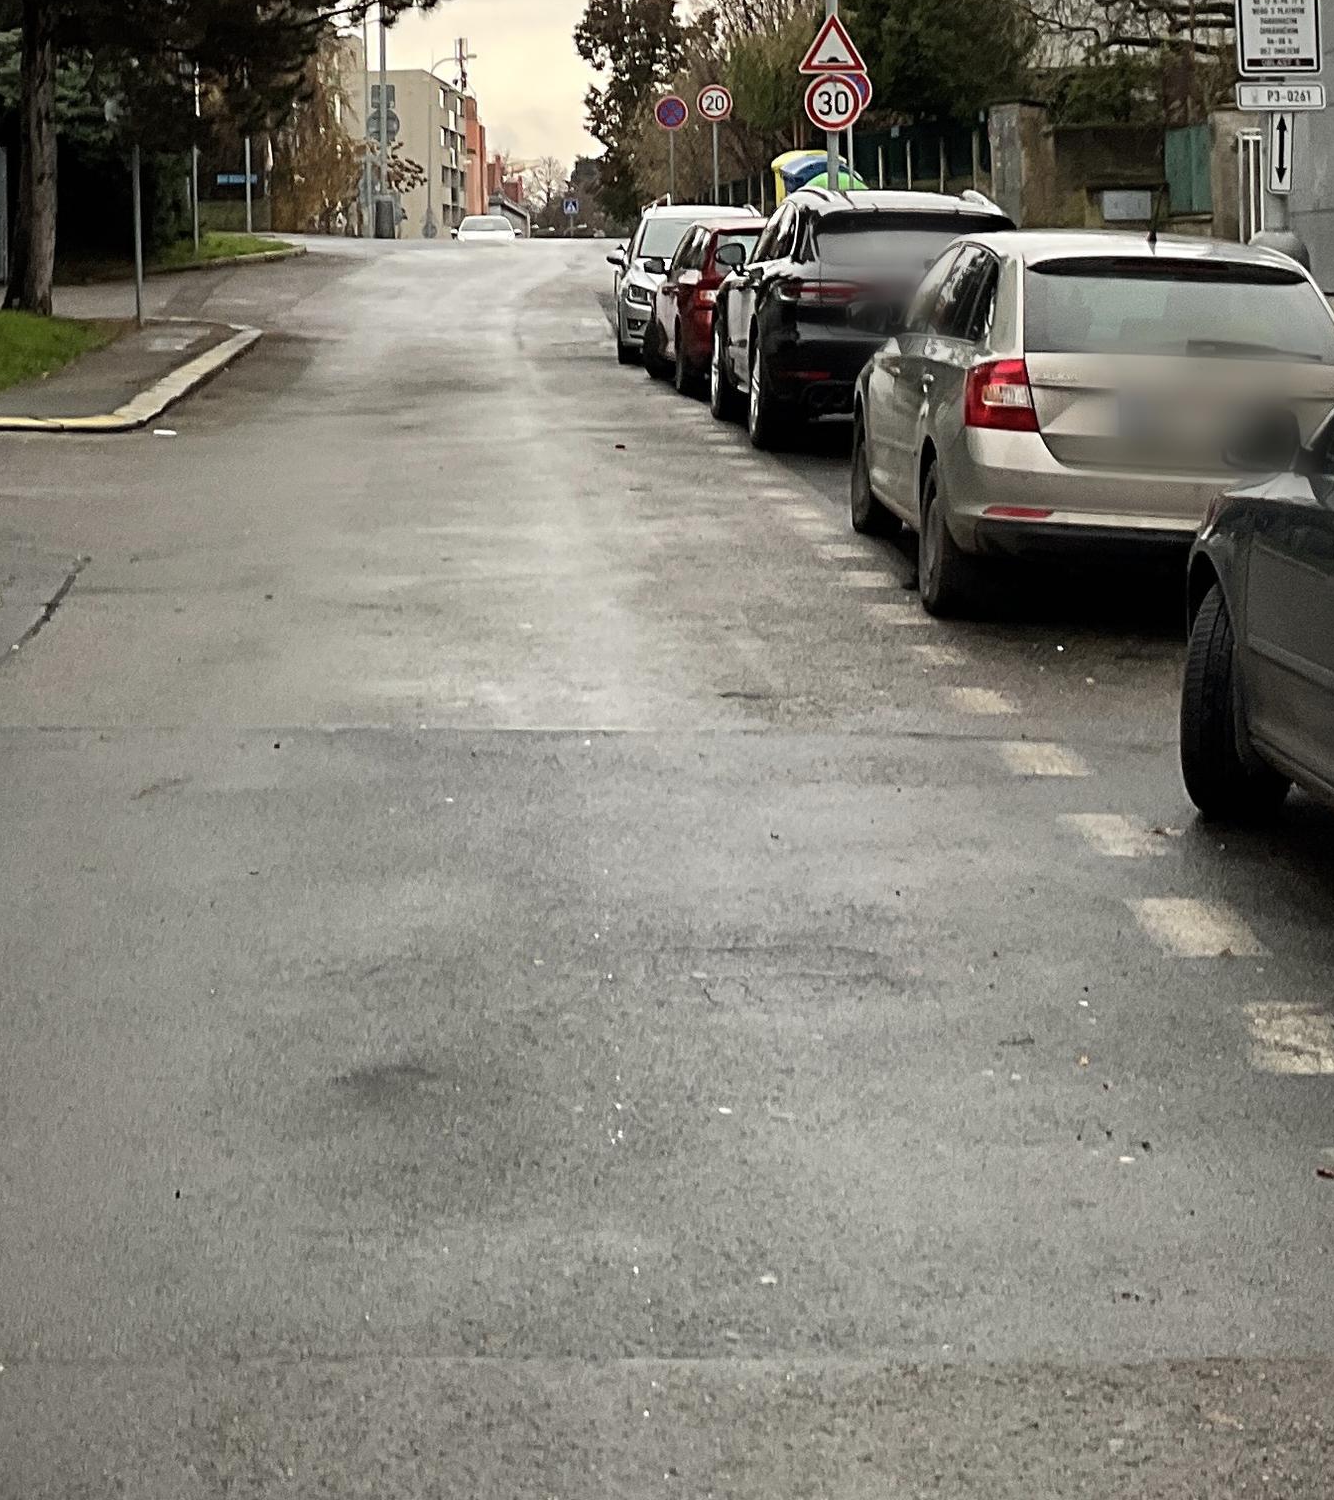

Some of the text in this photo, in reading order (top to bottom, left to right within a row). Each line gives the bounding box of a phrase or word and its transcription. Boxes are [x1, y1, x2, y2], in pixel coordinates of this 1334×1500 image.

[705, 96, 725, 111] 20
[818, 91, 849, 116] 30
[1267, 90, 1311, 102] P3-0261
